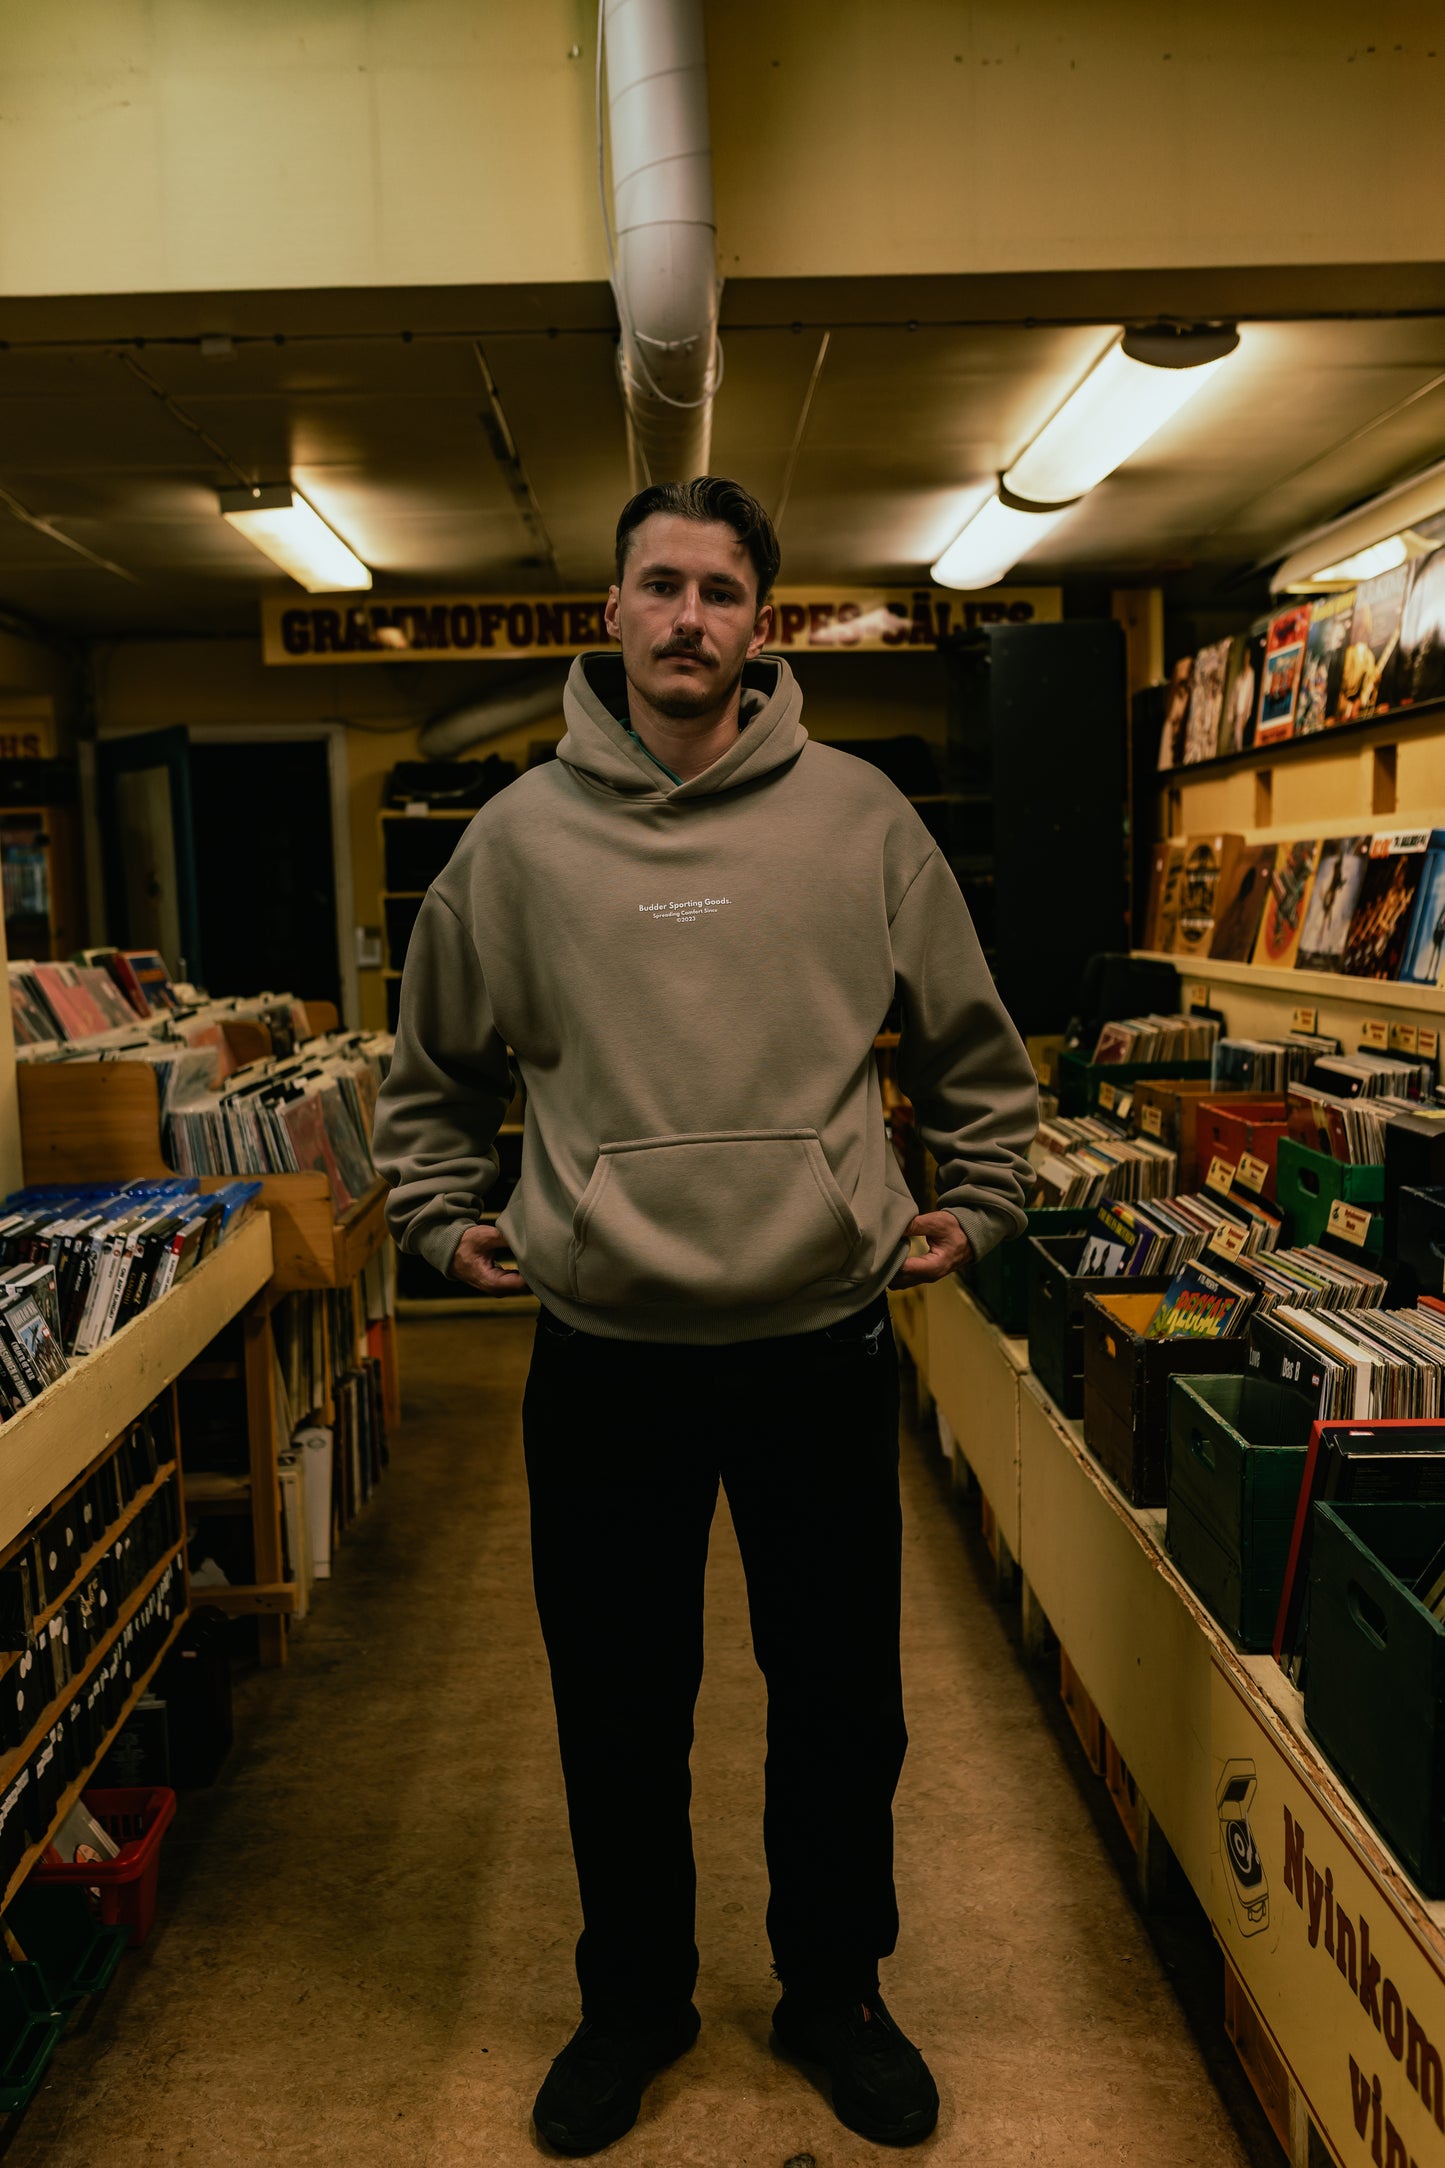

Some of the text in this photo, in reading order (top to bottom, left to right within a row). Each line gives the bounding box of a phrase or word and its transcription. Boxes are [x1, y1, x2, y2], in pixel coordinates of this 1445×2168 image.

[639, 897, 732, 912] Budder Sporting Goods.
[1349, 2053, 1420, 2168] vin
